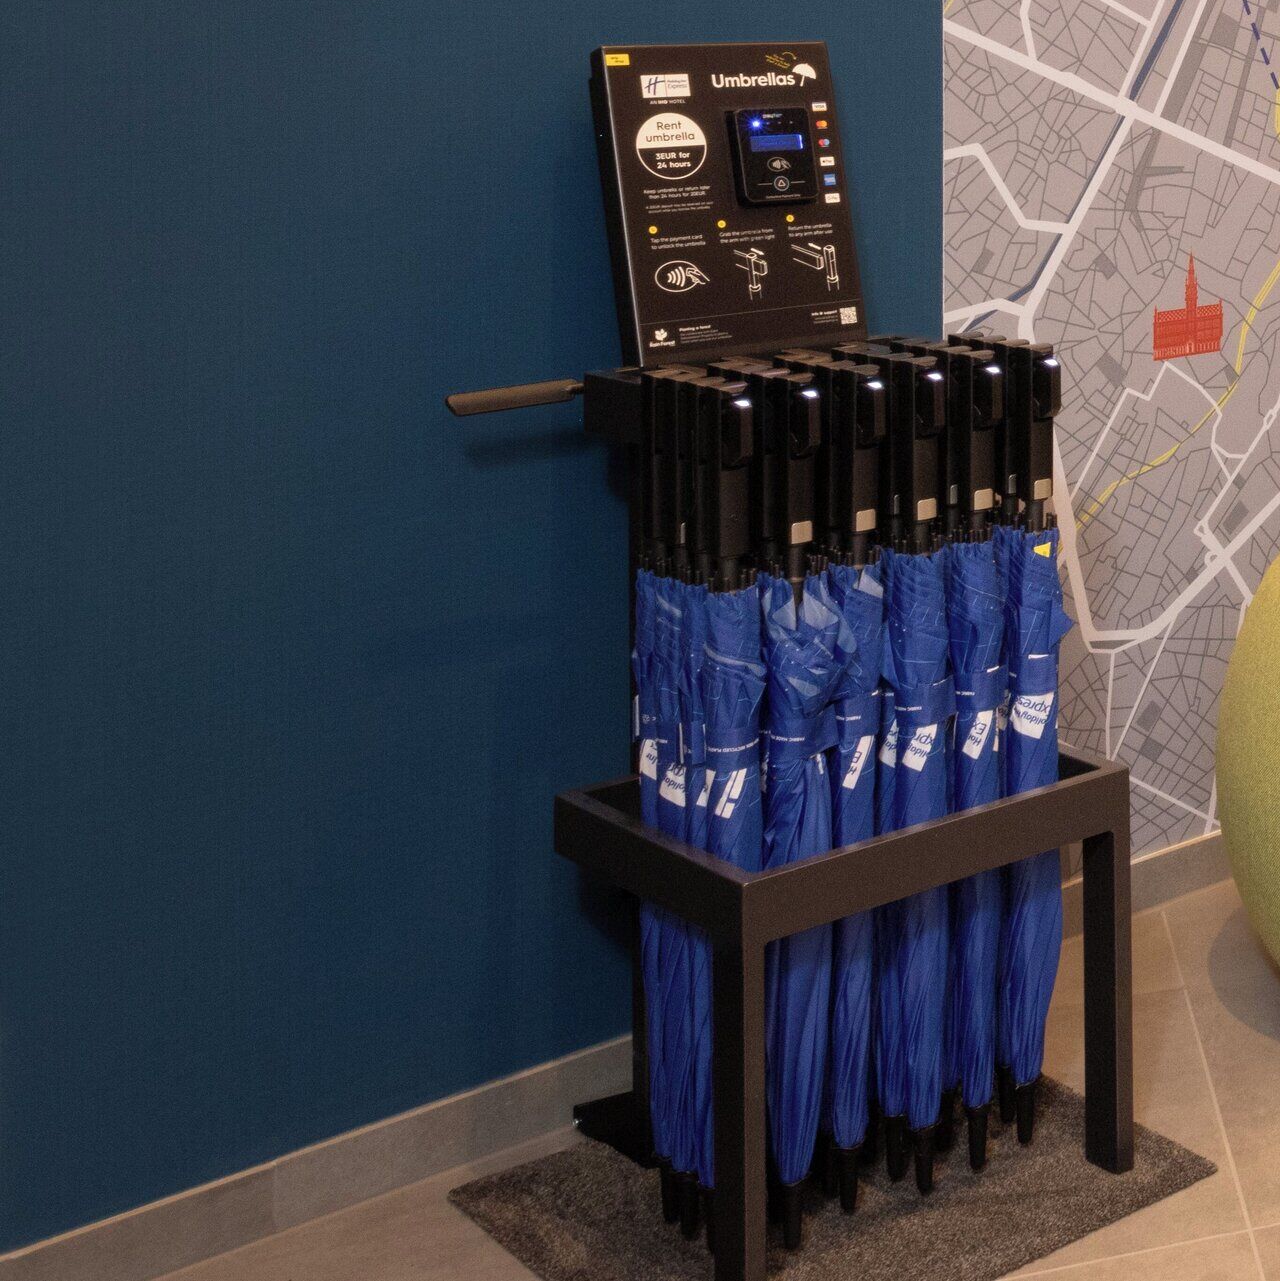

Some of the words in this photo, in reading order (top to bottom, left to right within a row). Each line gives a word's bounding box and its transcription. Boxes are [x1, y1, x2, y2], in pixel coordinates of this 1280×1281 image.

[711, 72, 796, 88] Umbrellas
[656, 121, 682, 130] Rent
[646, 132, 694, 142] umbrella
[656, 152, 676, 160] 3EUR
